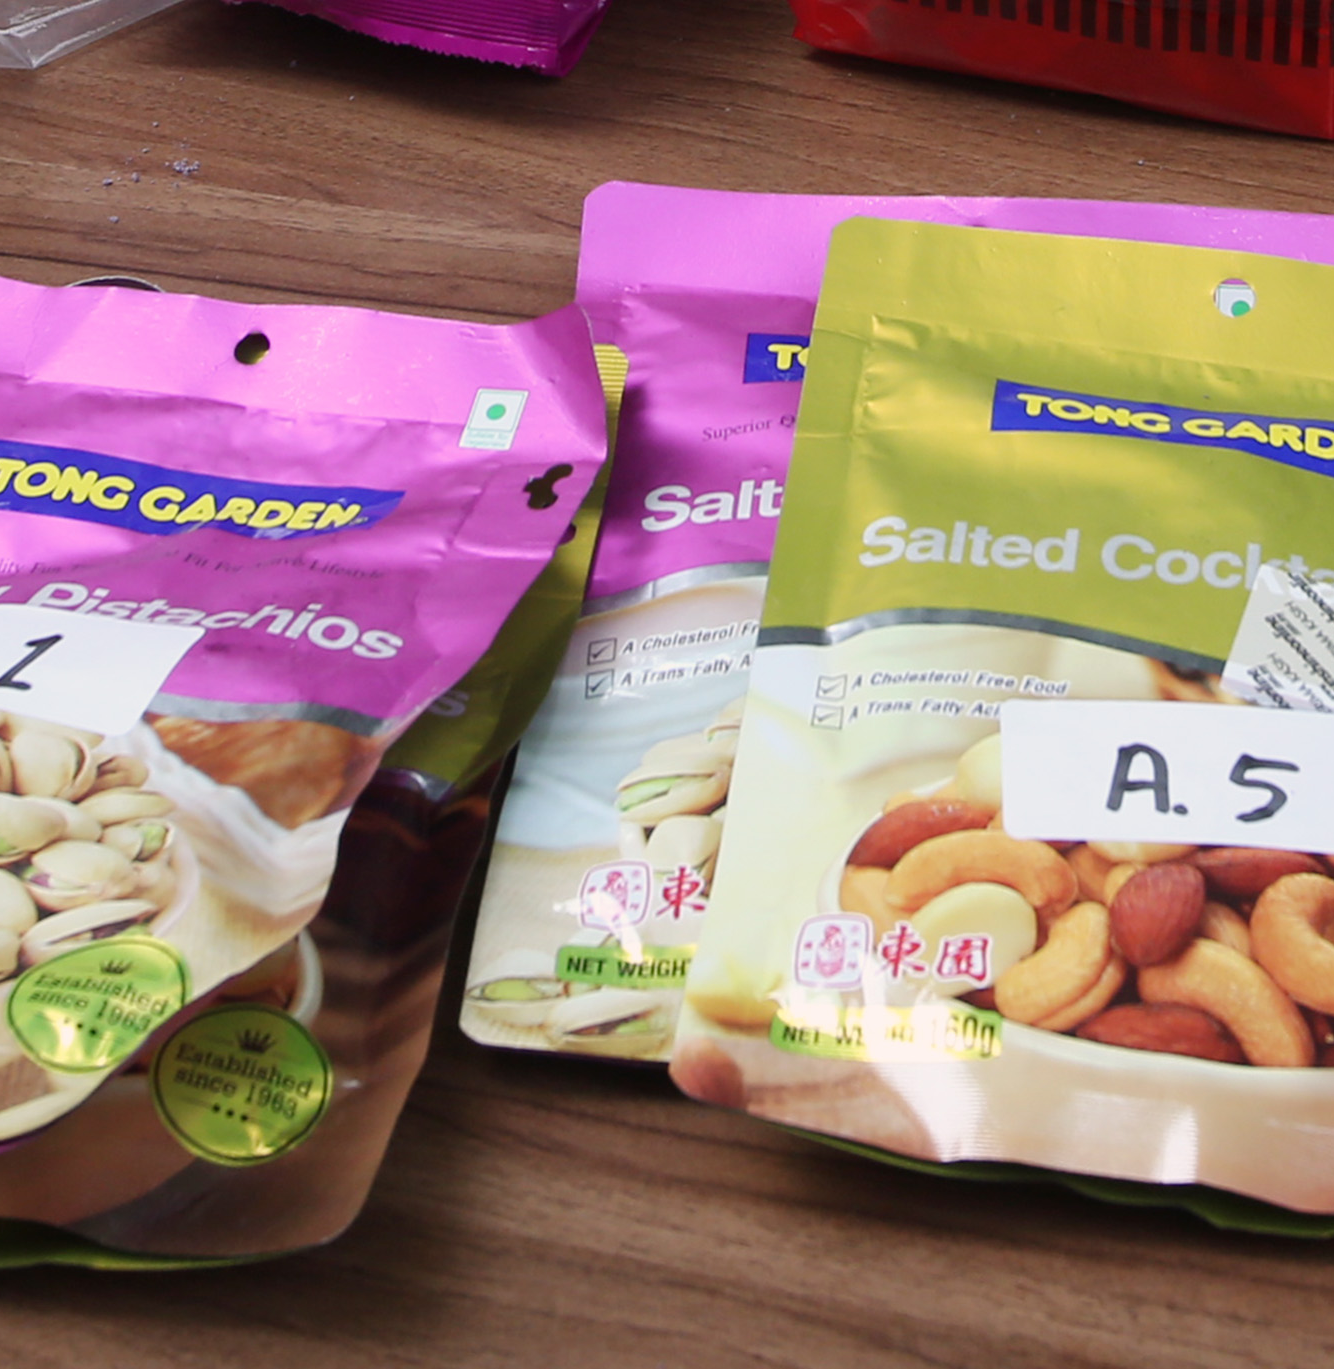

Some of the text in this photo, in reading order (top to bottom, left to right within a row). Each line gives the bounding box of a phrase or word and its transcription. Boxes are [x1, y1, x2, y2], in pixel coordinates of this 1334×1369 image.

[701, 419, 773, 442] Superior
[1017, 392, 1170, 434] TONG
[139, 487, 362, 531] GARDEN
[641, 479, 784, 532] Salt
[858, 515, 1078, 574] Salted
[27, 581, 405, 660] Pistachios
[622, 625, 734, 654] A Cholesterol
[621, 658, 733, 686] A Trans Fatty
[852, 671, 1067, 694] A Cholesterol Free Food
[849, 699, 999, 720] A Trans Fatty Aci
[567, 958, 606, 975] NET
[27, 989, 153, 1035] since 1963
[33, 973, 173, 1017] Established
[175, 1043, 314, 1099] Established
[173, 1068, 299, 1121] since 1963
